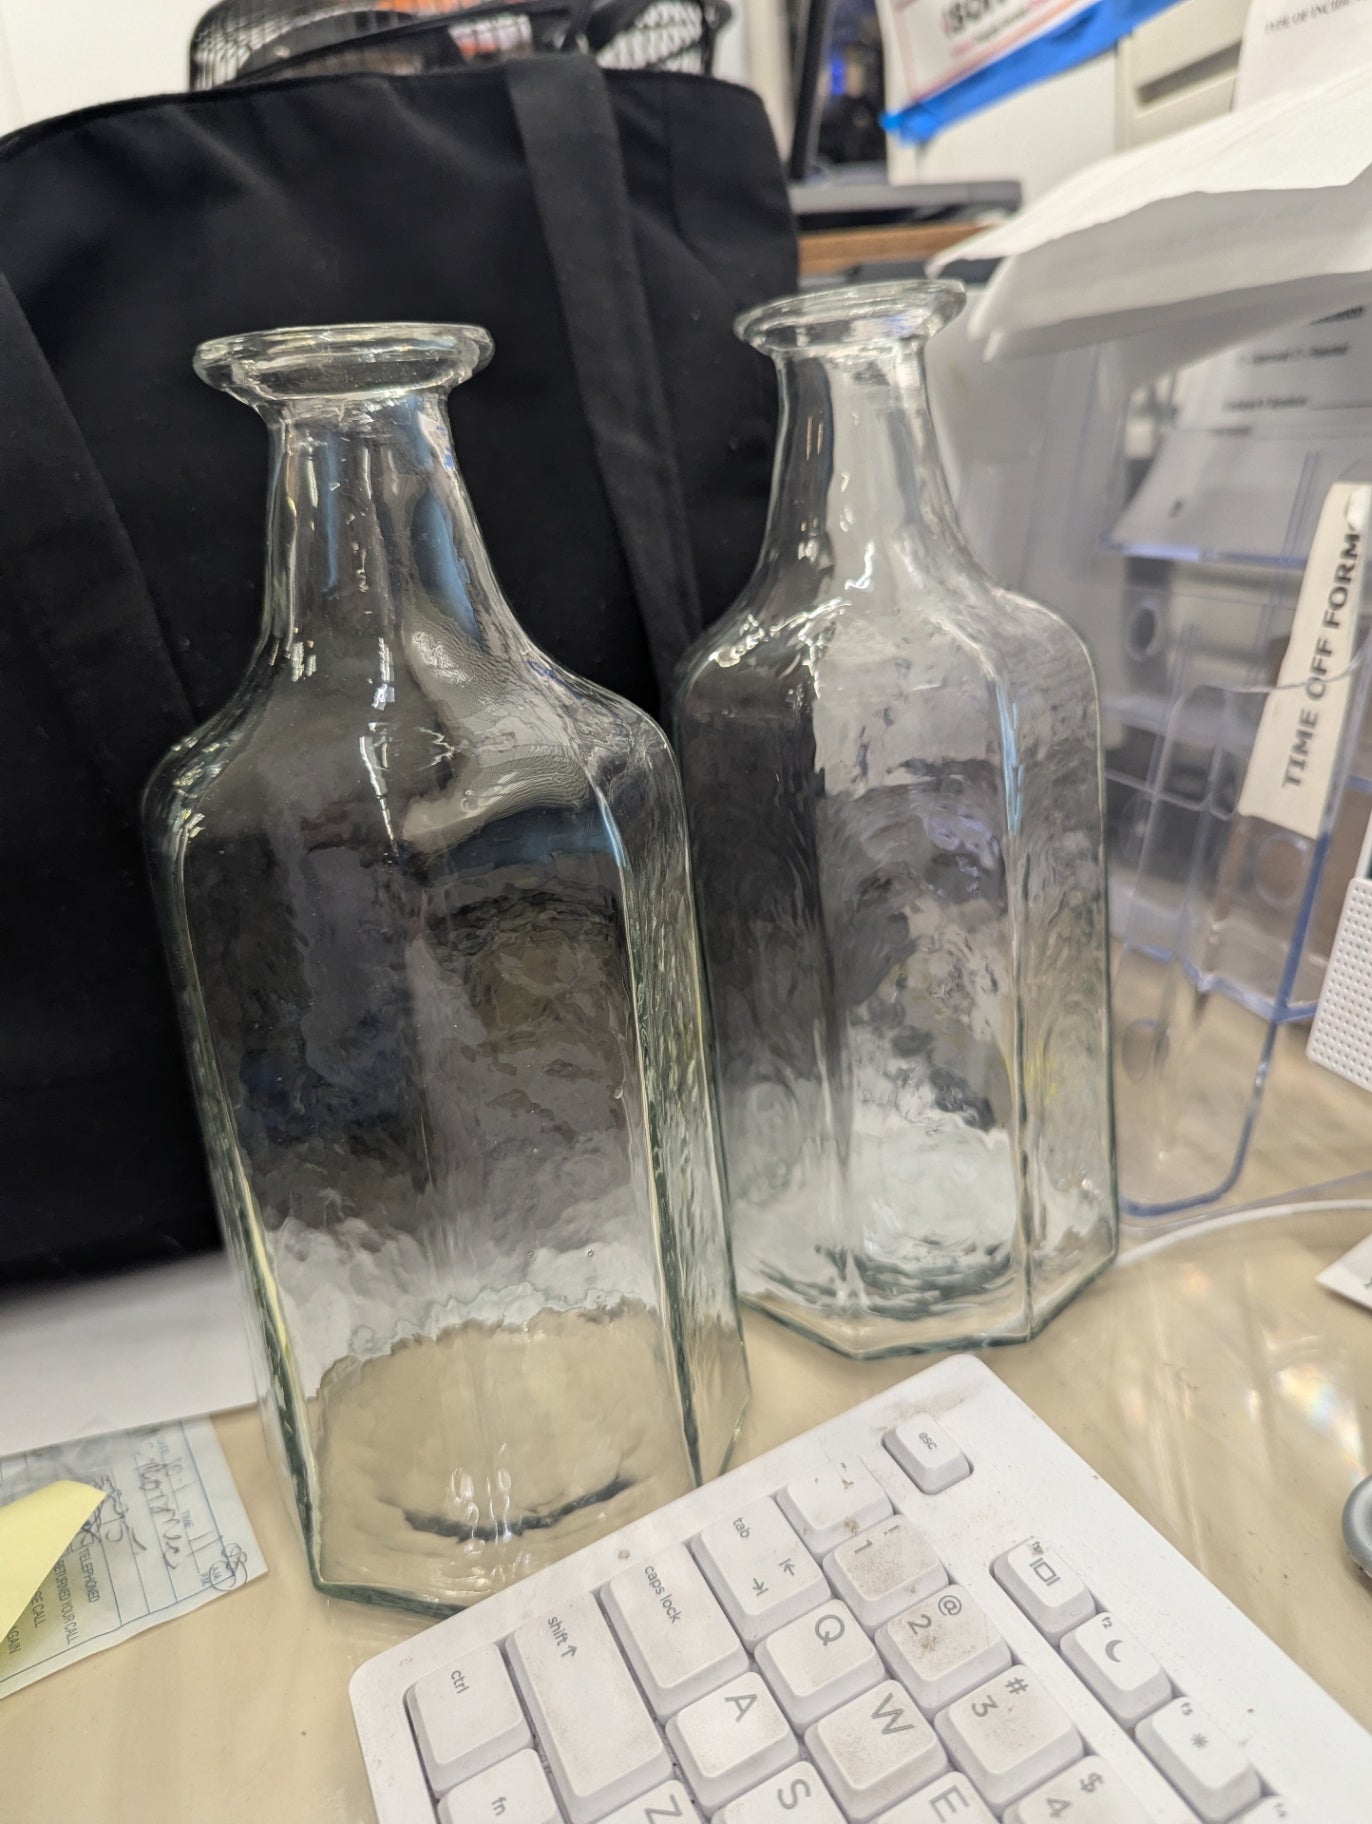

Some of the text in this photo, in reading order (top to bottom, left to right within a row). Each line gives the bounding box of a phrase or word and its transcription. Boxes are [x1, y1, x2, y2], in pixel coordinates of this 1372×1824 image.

[1281, 522, 1362, 788] TIME OFF FORM
[918, 1431, 938, 1451] esc
[181, 1510, 194, 1529] TIME
[733, 1517, 751, 1539] tab
[854, 1538, 874, 1555] 1
[80, 1546, 100, 1603] TELEPHONED
[54, 1560, 80, 1645] RETURNED YOUR CALL
[644, 1564, 682, 1624] caps lock
[938, 1595, 962, 1616] @
[32, 1603, 48, 1629] CALL
[907, 1613, 932, 1635] 2
[1101, 1616, 1113, 1630] f2
[548, 1616, 570, 1646] shift
[814, 1614, 846, 1646] Q
[450, 1669, 470, 1694] ctrl
[724, 1693, 758, 1723] A
[870, 1692, 915, 1735] W
[971, 1694, 999, 1718] 3
[777, 1778, 812, 1810] S
[1080, 1771, 1105, 1793] $
[491, 1796, 507, 1816] fn
[644, 1793, 683, 1824] Z
[928, 1784, 970, 1824] E
[1045, 1797, 1073, 1818] 4
